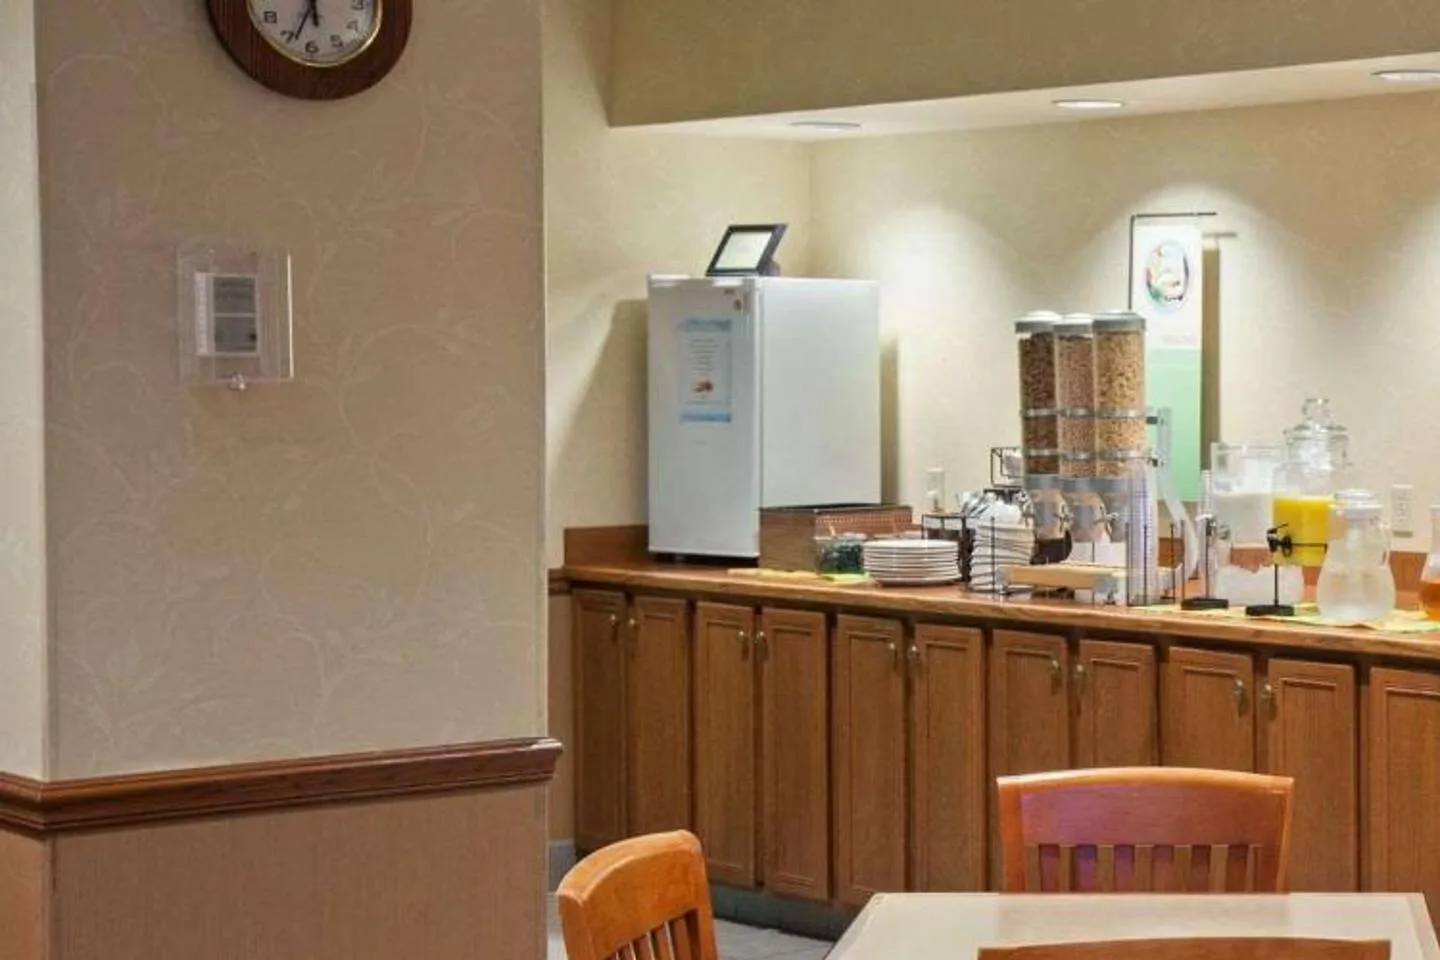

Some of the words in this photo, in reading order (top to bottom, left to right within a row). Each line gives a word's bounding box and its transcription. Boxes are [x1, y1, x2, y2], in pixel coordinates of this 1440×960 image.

[264, 11, 278, 24] 8
[346, 20, 359, 32] 4
[280, 30, 294, 44] 7
[329, 34, 344, 48] 5
[305, 40, 319, 54] 6
